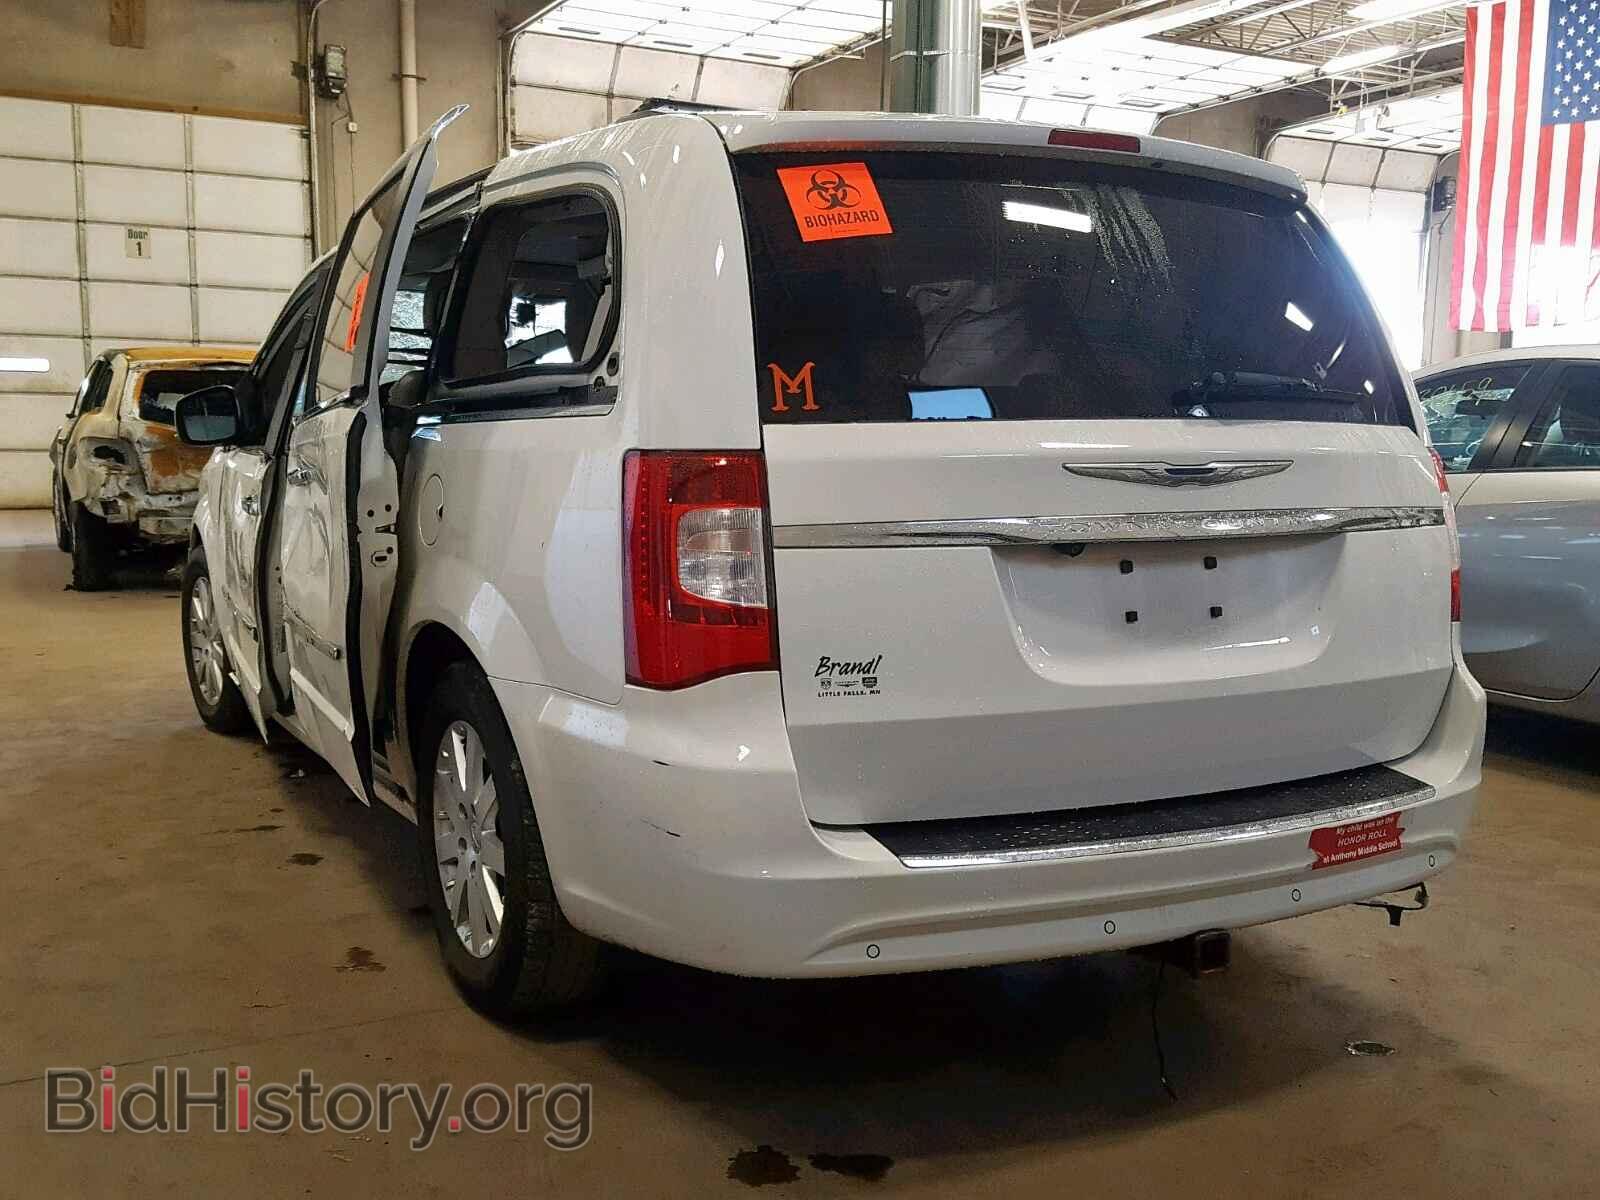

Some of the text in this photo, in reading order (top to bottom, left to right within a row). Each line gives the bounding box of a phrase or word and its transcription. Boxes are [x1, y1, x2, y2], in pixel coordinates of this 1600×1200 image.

[804, 209, 880, 228] BIOHAZARD
[136, 241, 142, 257] 1
[767, 361, 820, 411] M
[814, 654, 882, 677] Brandl
[1336, 827, 1345, 835] My
[1346, 824, 1363, 833] child
[1337, 830, 1387, 848] HONOR ROLL
[1331, 851, 1357, 862] Anthony
[1357, 845, 1378, 856] Middle
[1378, 839, 1398, 851] School
